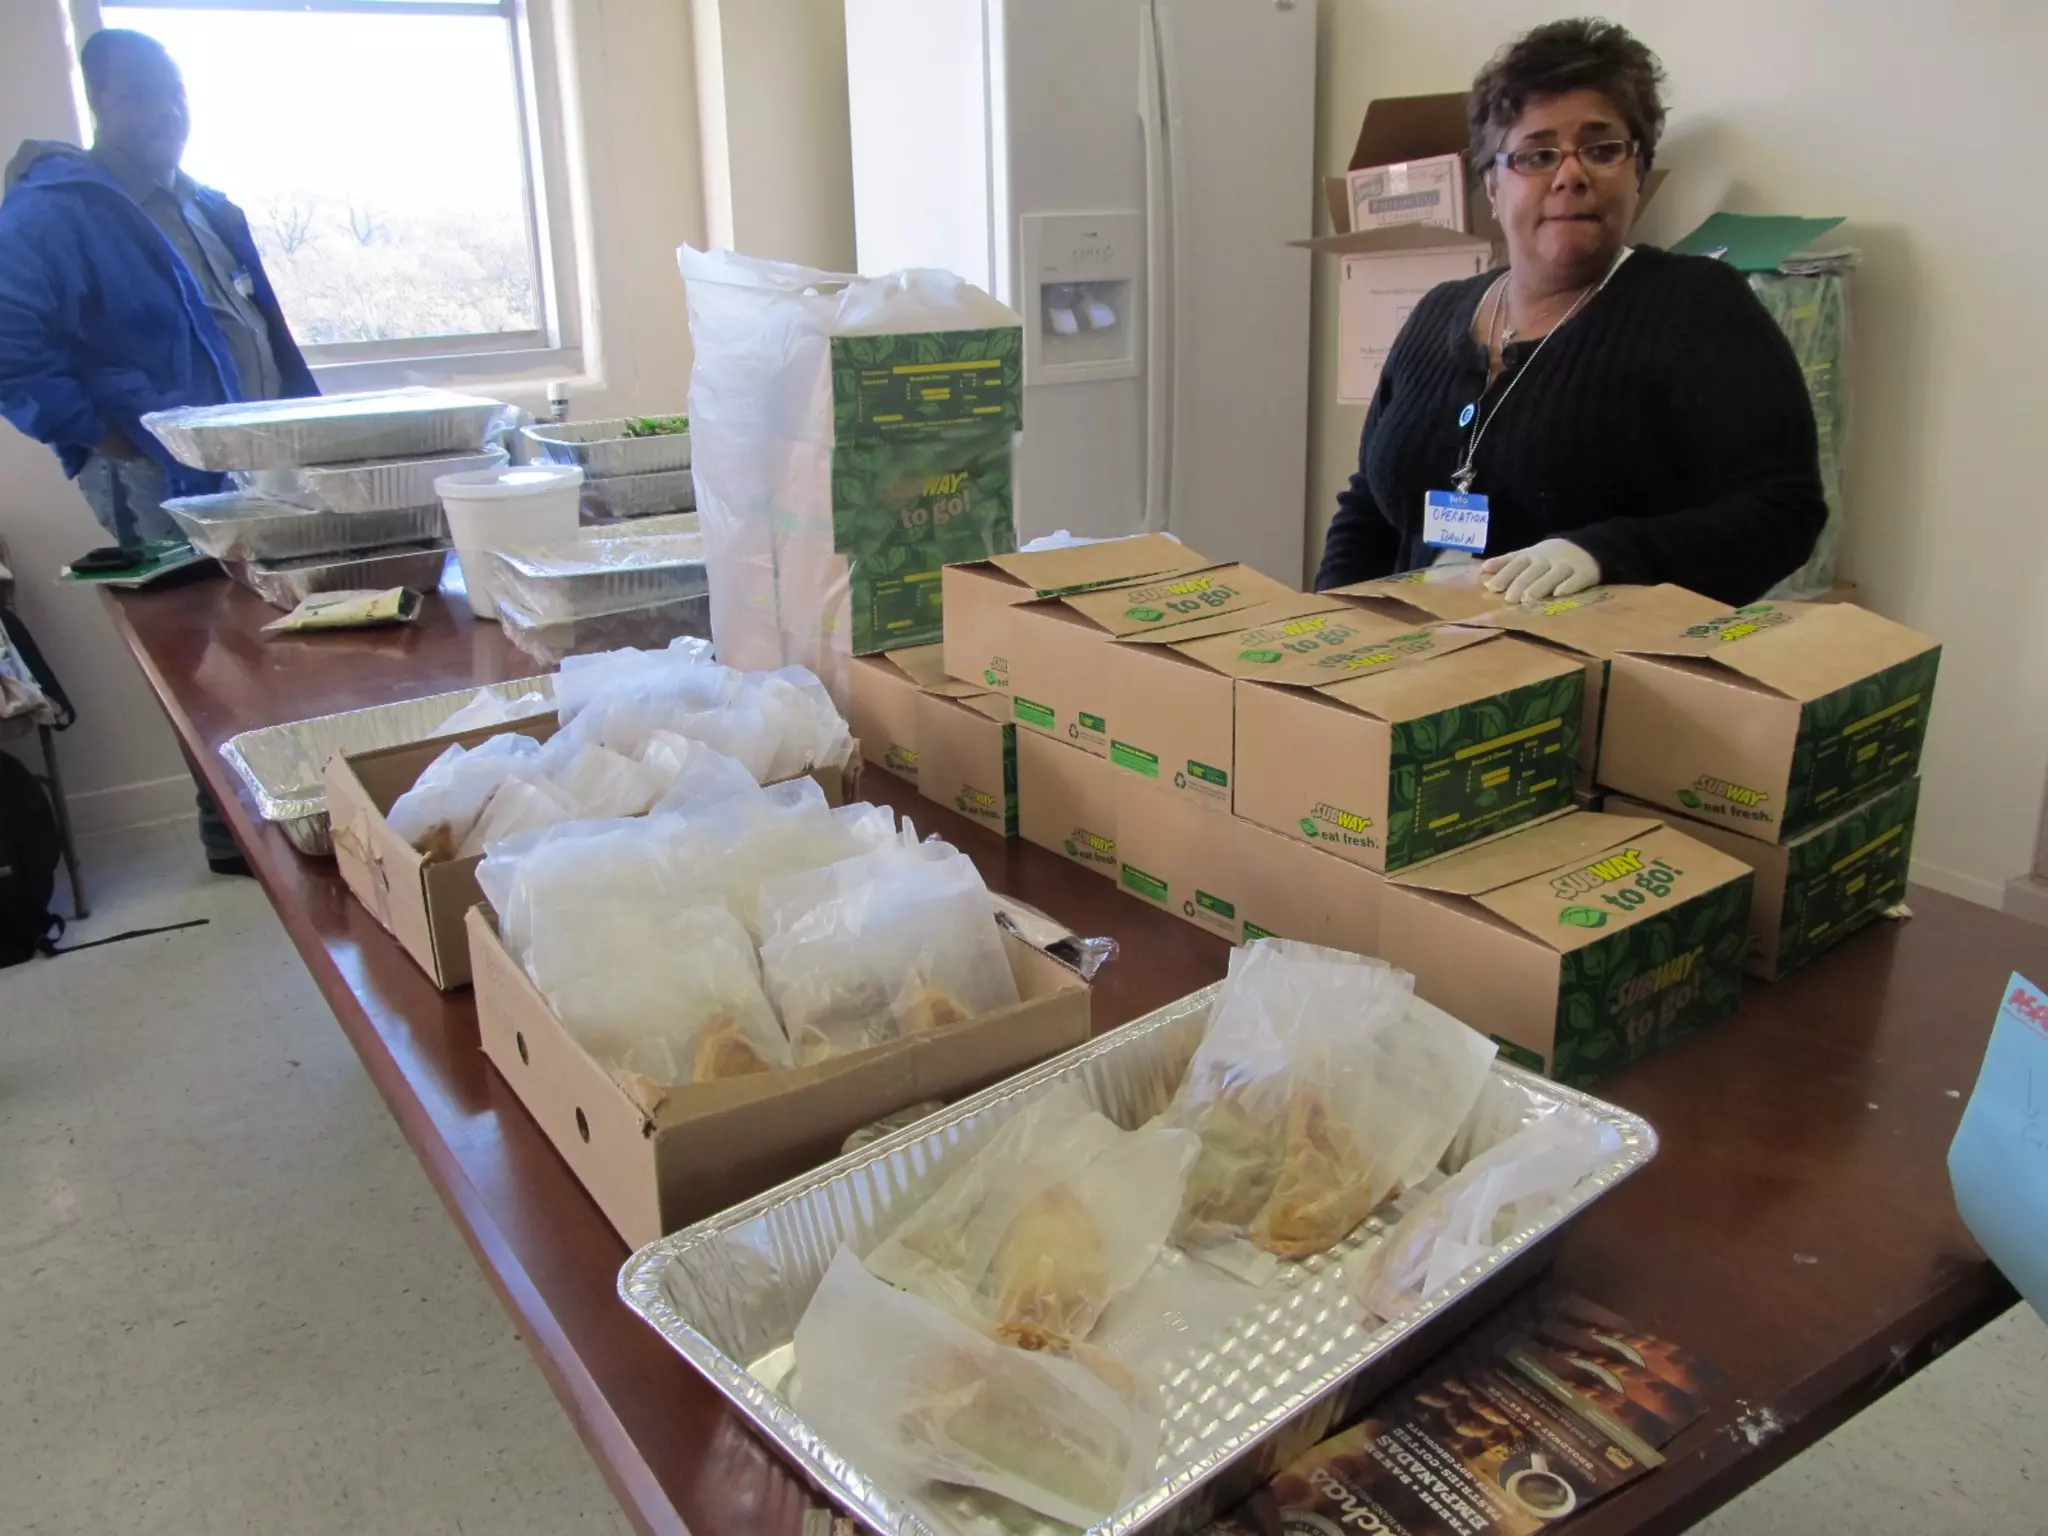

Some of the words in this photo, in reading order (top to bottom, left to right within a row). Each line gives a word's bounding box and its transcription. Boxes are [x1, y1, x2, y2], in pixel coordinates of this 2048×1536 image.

[901, 508, 928, 530] to
[933, 489, 970, 525] go!
[1433, 508, 1487, 523] OPERATION
[1441, 529, 1475, 544] DAWN
[1128, 577, 1213, 604] SUBWAY
[1165, 600, 1201, 614] to
[1197, 585, 1240, 608] go!
[1240, 616, 1327, 647] SUBWAY
[1281, 639, 1320, 653] to
[1315, 624, 1361, 646] go!
[990, 656, 1008, 673] SUB
[1693, 774, 1768, 808] SUBWAY
[1310, 802, 1374, 833] SUBWAY
[1704, 803, 1726, 815] eat
[1321, 831, 1340, 842] eat
[1550, 848, 1645, 900] SUBWAY
[1601, 888, 1645, 911] to
[1635, 857, 1684, 898] go!
[1609, 944, 1704, 1015] SUBWAY
[1624, 1011, 1654, 1044] to
[1392, 1426, 1439, 1467] COFFEE
[1405, 1421, 1455, 1464] CHOCOLATE
[1539, 1426, 1594, 1470] BROADWAY
[1362, 1441, 1412, 1485] BAKED
[1452, 1461, 1473, 1480] HOT
[1375, 1432, 1489, 1532] EMPANADAS
[1439, 1466, 1502, 1522] PASTRIES
[1418, 1490, 1472, 1536] FRESH
